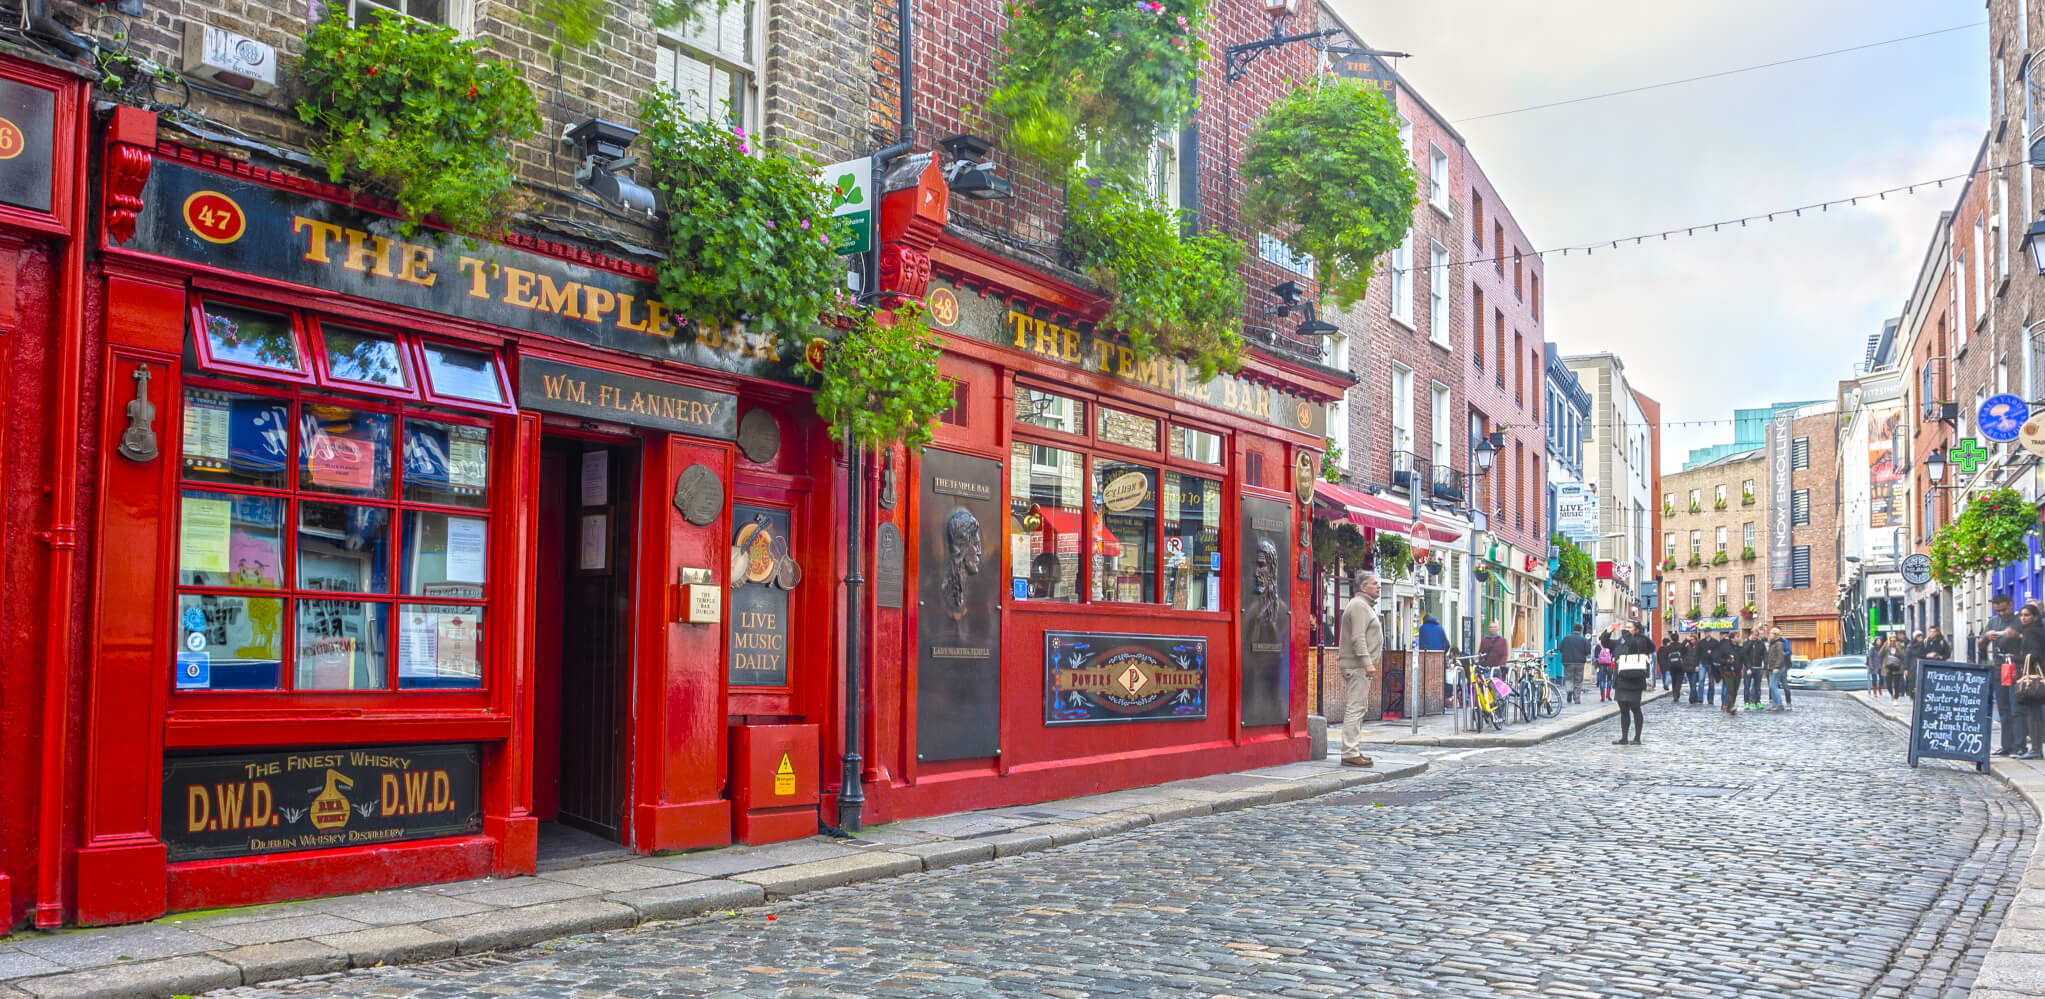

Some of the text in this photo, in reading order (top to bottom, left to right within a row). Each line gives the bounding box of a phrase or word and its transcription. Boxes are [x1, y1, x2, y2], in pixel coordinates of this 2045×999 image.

[1345, 61, 1370, 72] THE
[0, 127, 13, 150] 6
[198, 205, 232, 231] 47
[293, 215, 437, 288] THE
[458, 256, 677, 339] TEMPLE
[935, 294, 954, 321] 48
[1007, 310, 1270, 419] THE TEMPLE BAR
[542, 373, 720, 426] WM. FLANNERY
[1775, 415, 1787, 503] ENROLLING
[935, 477, 949, 488] THE
[950, 480, 975, 491] TEMPLE
[1560, 503, 1583, 512] LIVE
[1776, 507, 1787, 548] NOW
[741, 611, 777, 630] LIVE
[734, 631, 783, 651] MUSIC
[735, 652, 780, 671] DAILY
[1071, 668, 1193, 691] POWERS P WHISKEY
[1926, 670, 1955, 683] Mexico
[1935, 682, 1981, 694] Lunch Deal
[1924, 693, 1953, 704] Starter
[1959, 694, 1981, 705] Main
[1933, 704, 1951, 715] glass
[1954, 713, 1976, 723] drink
[1923, 730, 1984, 754] Around 9.95
[245, 751, 411, 780] THE FINEST WHISKY
[380, 769, 455, 818] D.W.D.
[187, 780, 280, 834] D.W.D.
[250, 828, 405, 851] DUBLIN WHISKY DISTILLERY
